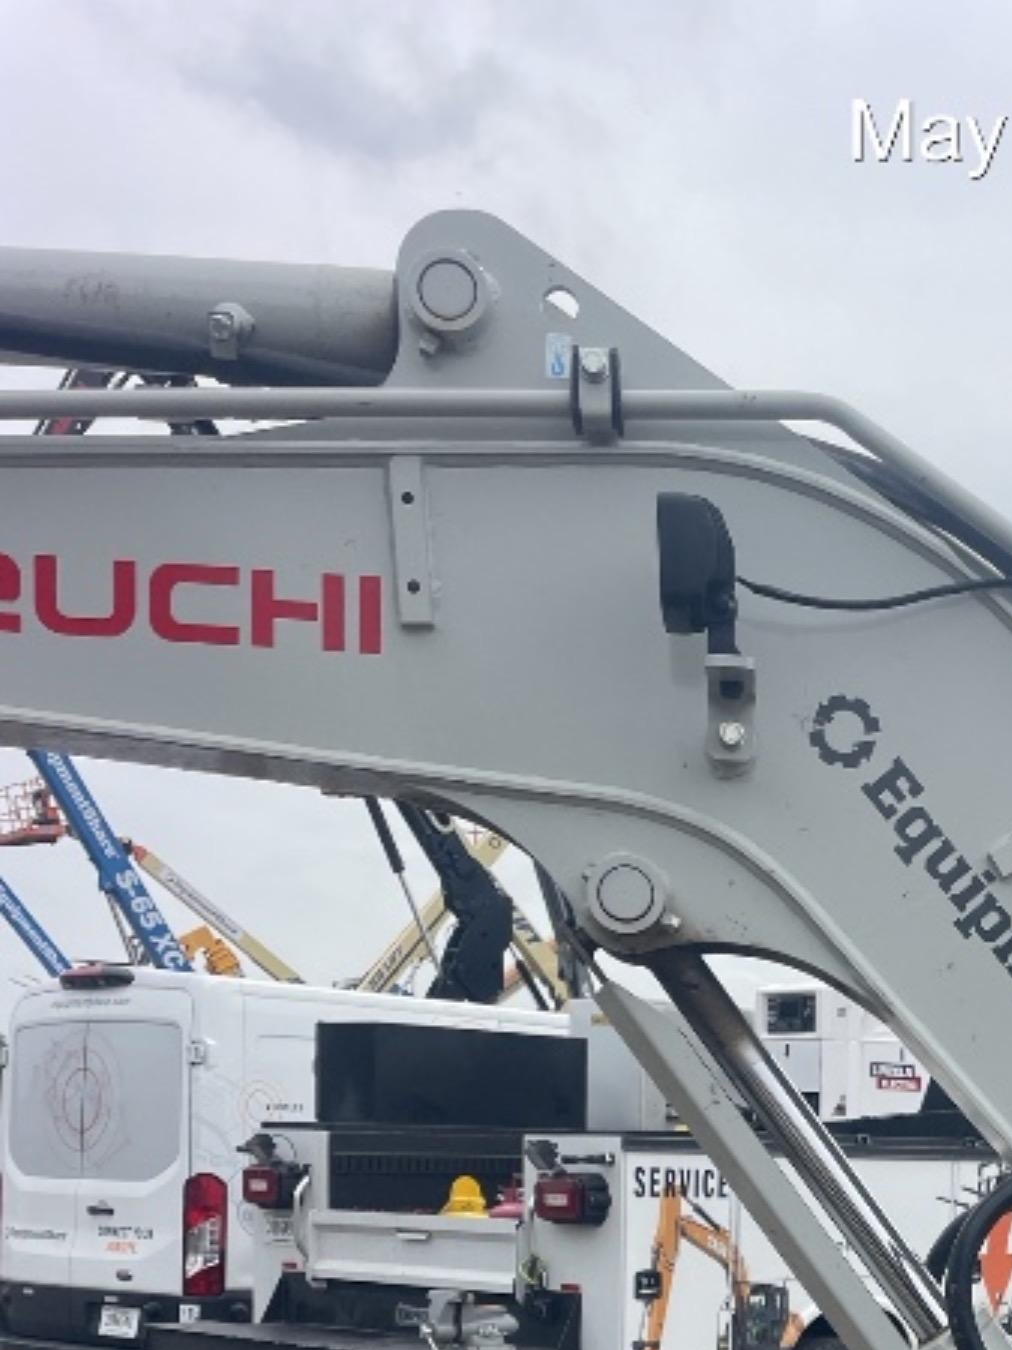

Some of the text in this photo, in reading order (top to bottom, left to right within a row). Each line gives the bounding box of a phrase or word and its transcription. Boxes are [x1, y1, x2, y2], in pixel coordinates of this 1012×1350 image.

[115, 868, 186, 971] S-65 XC
[634, 1166, 728, 1198] SERVICE
